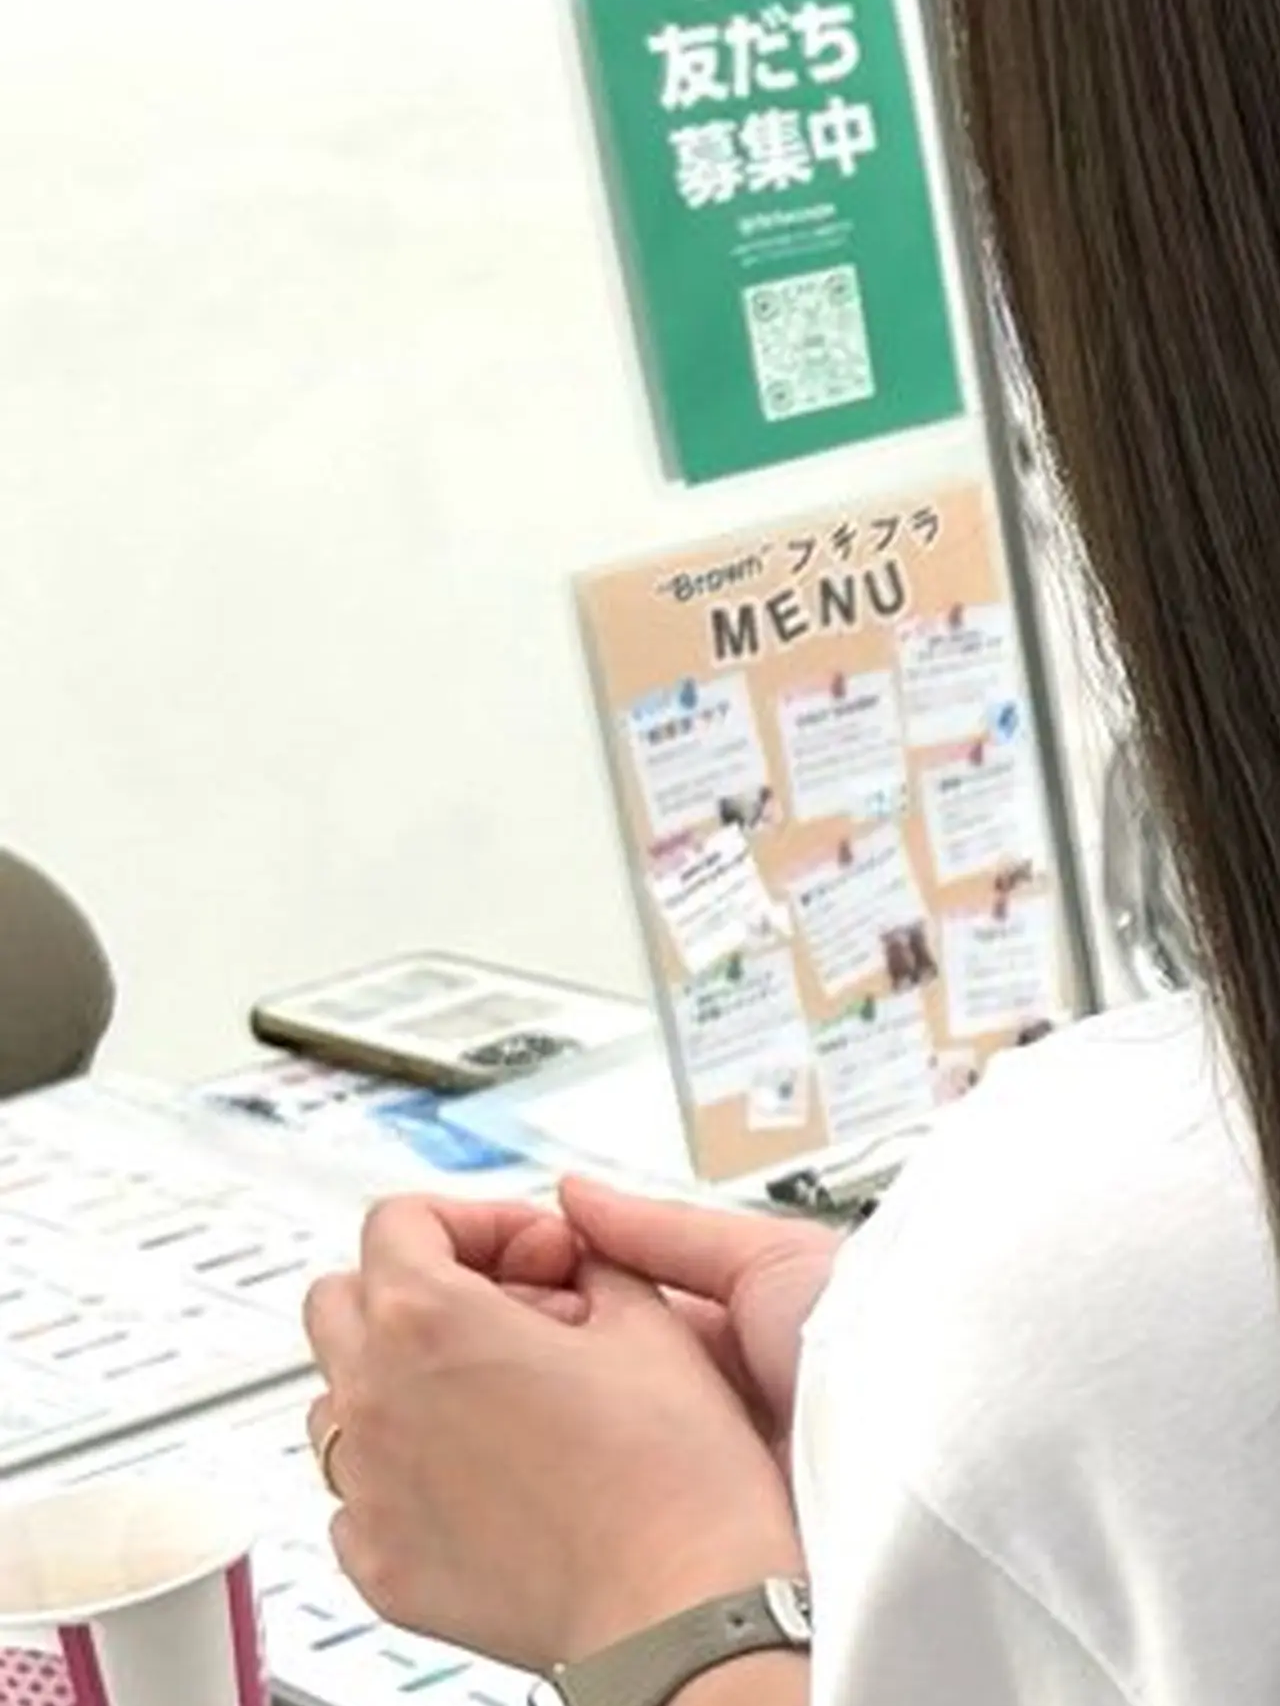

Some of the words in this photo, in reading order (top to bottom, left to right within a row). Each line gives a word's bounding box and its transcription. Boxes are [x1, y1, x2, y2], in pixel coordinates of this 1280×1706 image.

[646, 0, 861, 110] 友だち
[668, 95, 877, 209] 募集中
[710, 559, 905, 660] MENU
